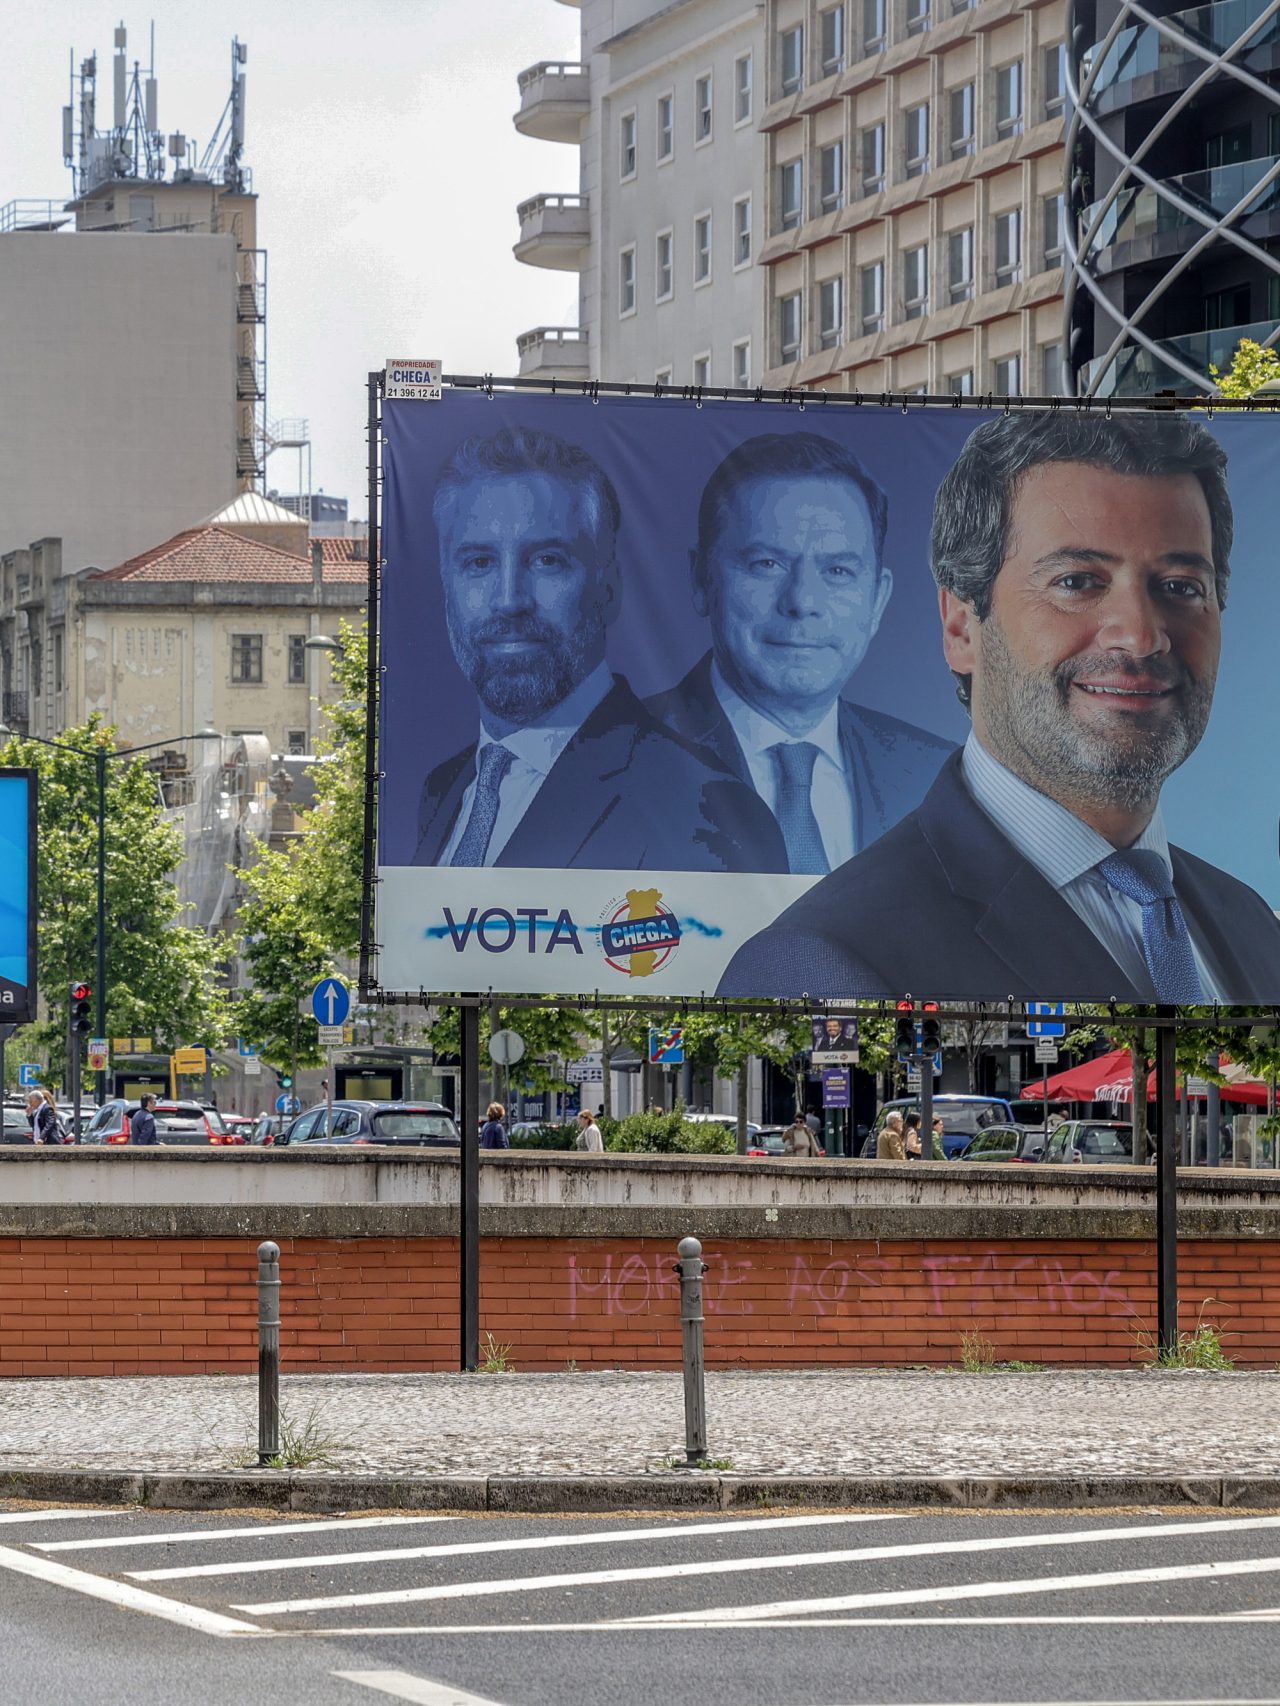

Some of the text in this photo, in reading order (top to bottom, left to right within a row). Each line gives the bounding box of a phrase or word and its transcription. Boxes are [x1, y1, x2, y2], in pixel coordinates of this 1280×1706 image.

[393, 370, 431, 383] CHEGA
[388, 388, 440, 397] 21 396 12 44
[442, 906, 673, 954] VOTA CHEGA
